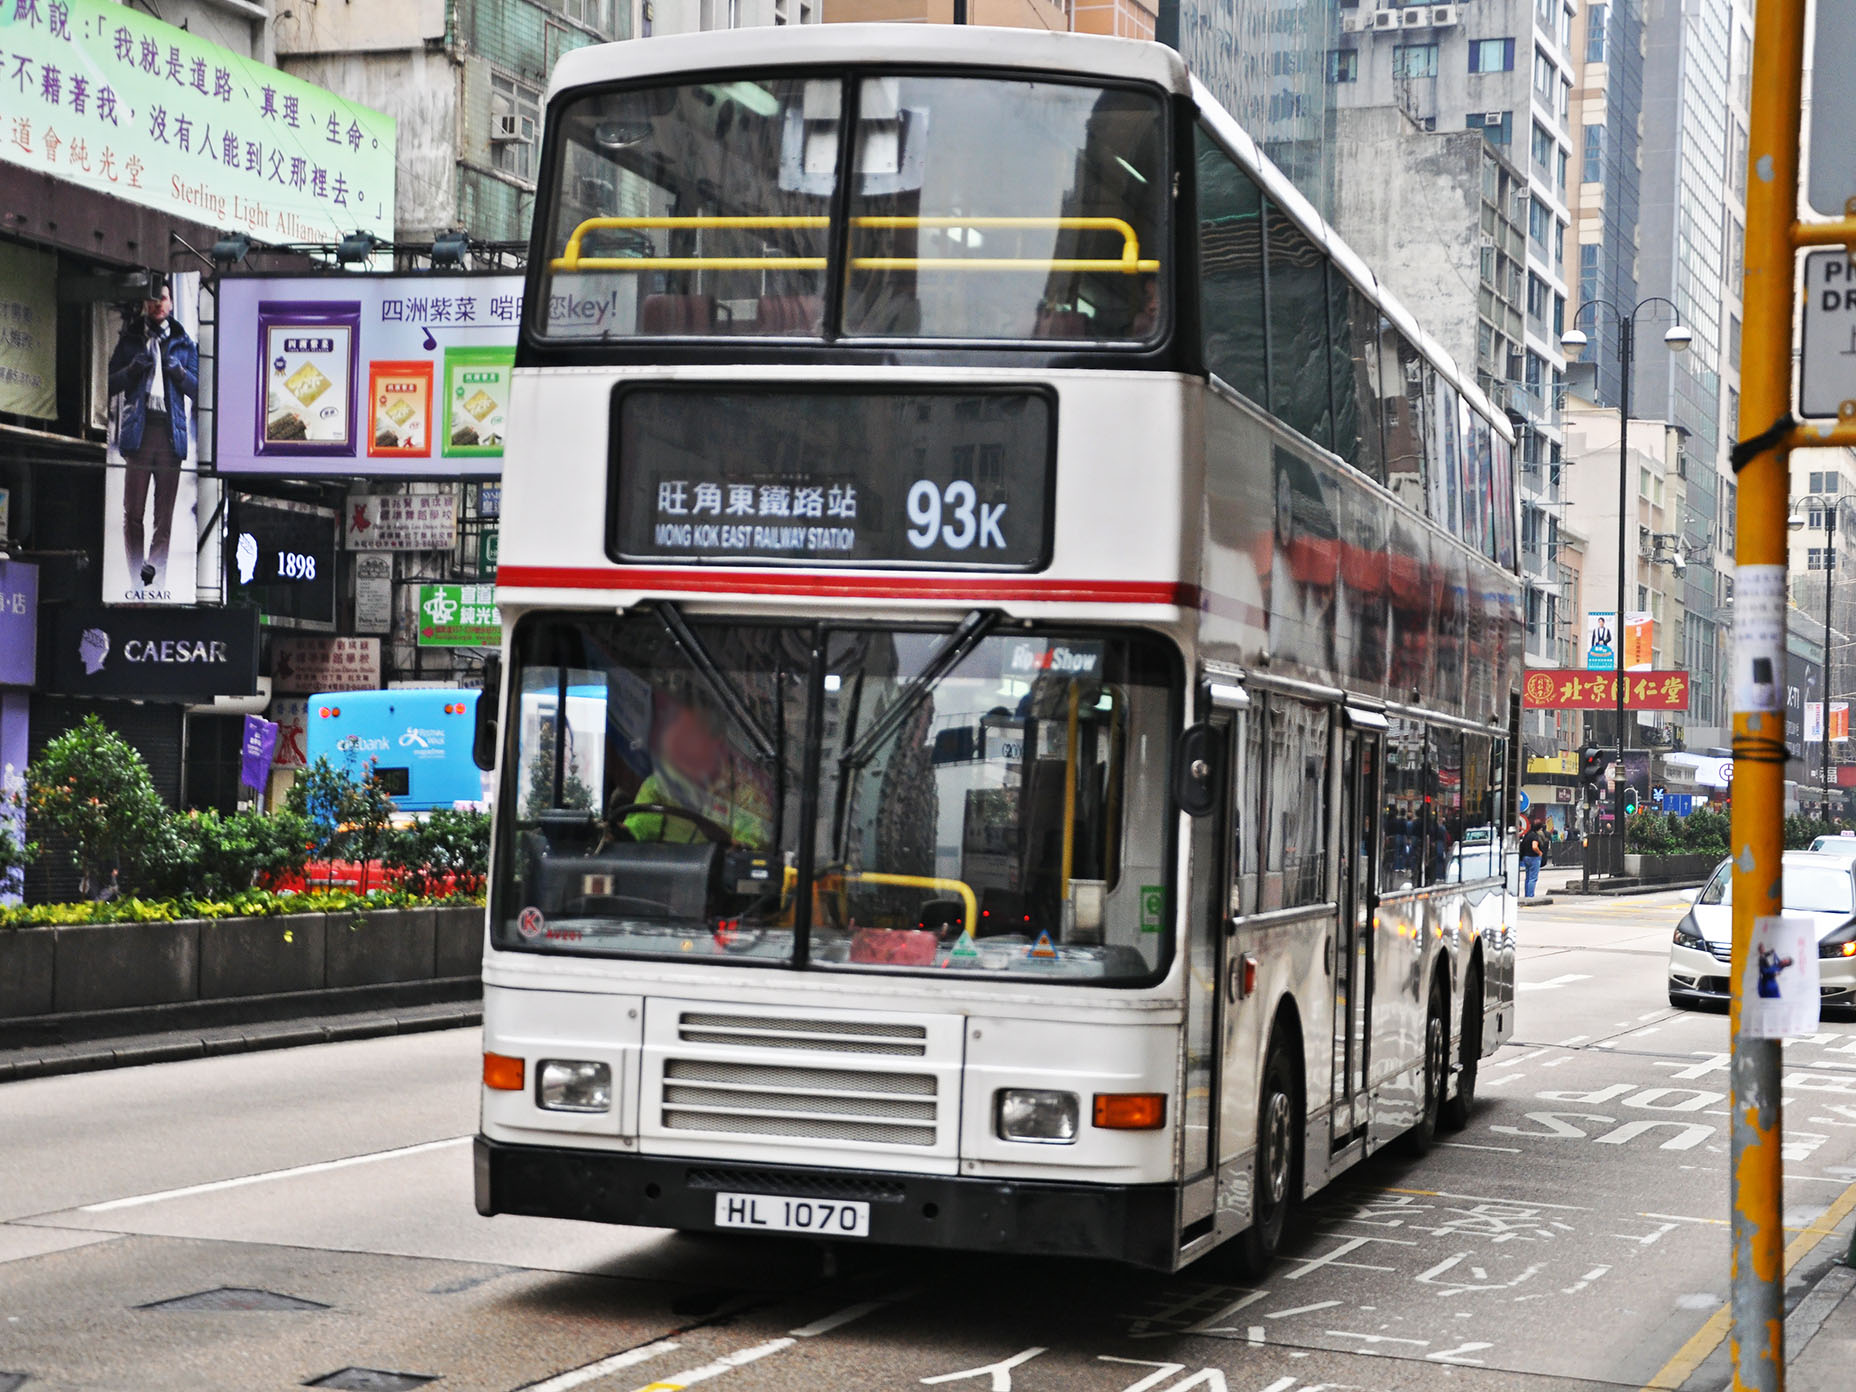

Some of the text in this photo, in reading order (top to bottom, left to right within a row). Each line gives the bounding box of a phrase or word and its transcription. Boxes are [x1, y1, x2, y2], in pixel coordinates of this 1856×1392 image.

[171, 173, 226, 221] Sterling
[233, 195, 269, 231] Light
[381, 296, 477, 323] 四洲紫菜
[657, 480, 857, 518] 旺角東鐵路站
[655, 523, 692, 547] MONG
[693, 524, 720, 548] KOK
[721, 525, 753, 549] EAST
[753, 526, 807, 549] RAILWAY
[277, 550, 316, 580] 1898
[124, 590, 172, 601] CAESAR
[124, 639, 228, 663] CAESAR
[727, 1197, 857, 1231] HL 1070
